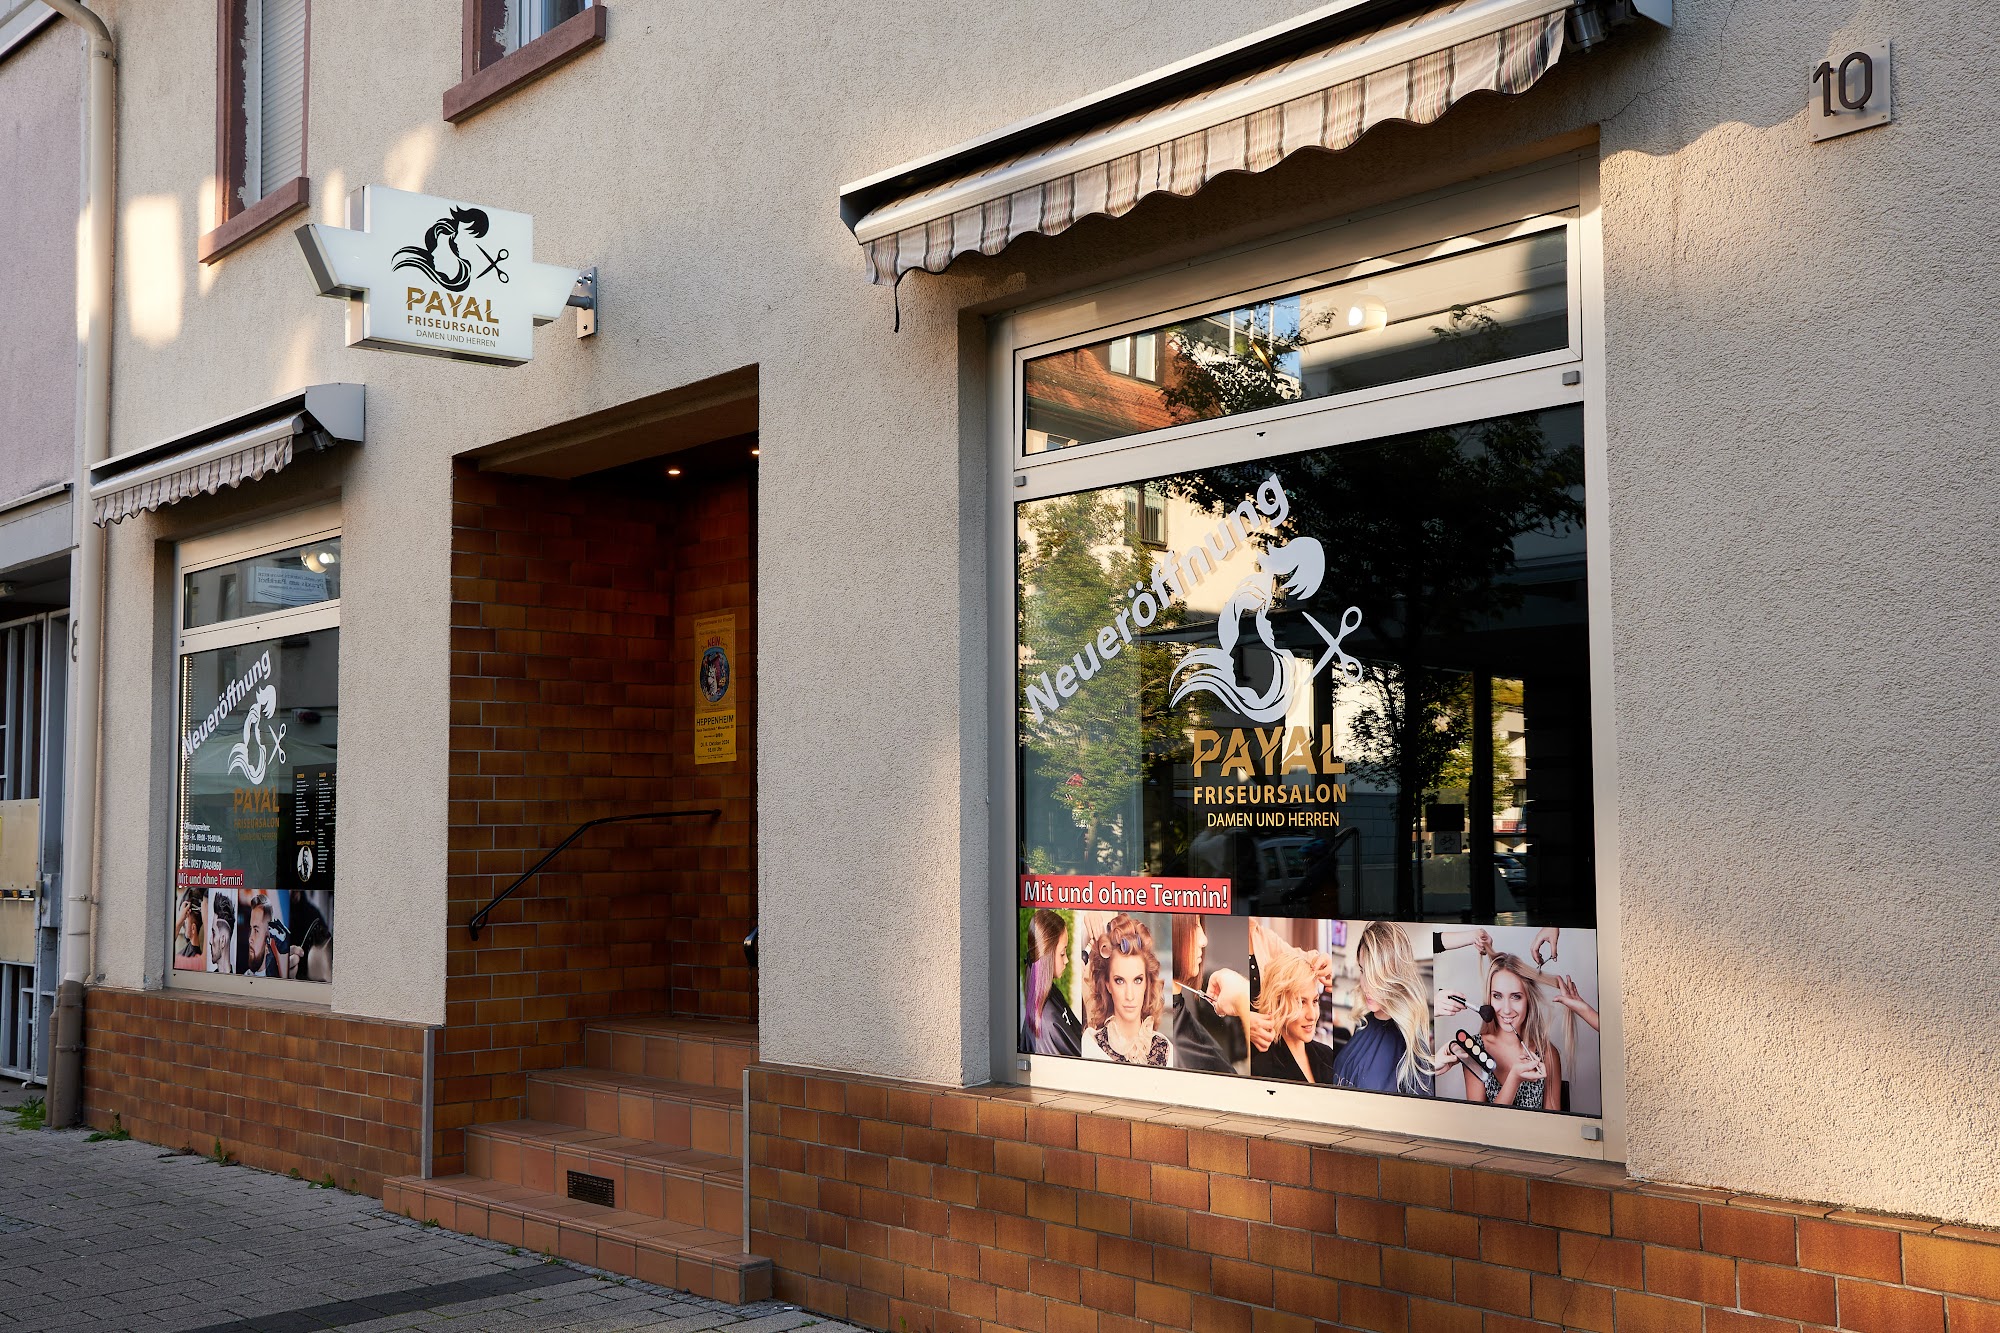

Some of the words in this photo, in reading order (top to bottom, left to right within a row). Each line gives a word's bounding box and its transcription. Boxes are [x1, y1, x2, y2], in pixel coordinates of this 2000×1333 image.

[1812, 51, 1873, 117] 10
[406, 286, 499, 324] PAYAL
[407, 314, 500, 337] FRISEURSALON
[416, 329, 445, 341] DAMEN
[447, 334, 465, 343] UND
[466, 337, 496, 348] HERREN
[1023, 473, 1290, 725] Neueröffnung
[181, 649, 272, 760] Neueröffnung
[696, 714, 734, 726] HEPPENHEIM
[1190, 723, 1346, 778] PAYAL
[233, 785, 280, 814] PAYAL
[1193, 783, 1347, 805] FRISEURSALON
[233, 817, 280, 829] FRISEURSALON
[1207, 812, 1252, 827] DAMEN
[1256, 811, 1285, 827] UND
[1288, 811, 1340, 827] HERREN
[178, 872, 188, 884] Mit
[189, 872, 202, 885] und
[202, 872, 218, 885] ohne
[218, 873, 243, 886] Termin!
[1024, 880, 1054, 903] Mit
[1058, 880, 1094, 904] und
[1098, 881, 1147, 906] ohne
[1150, 883, 1228, 909] Termin!
